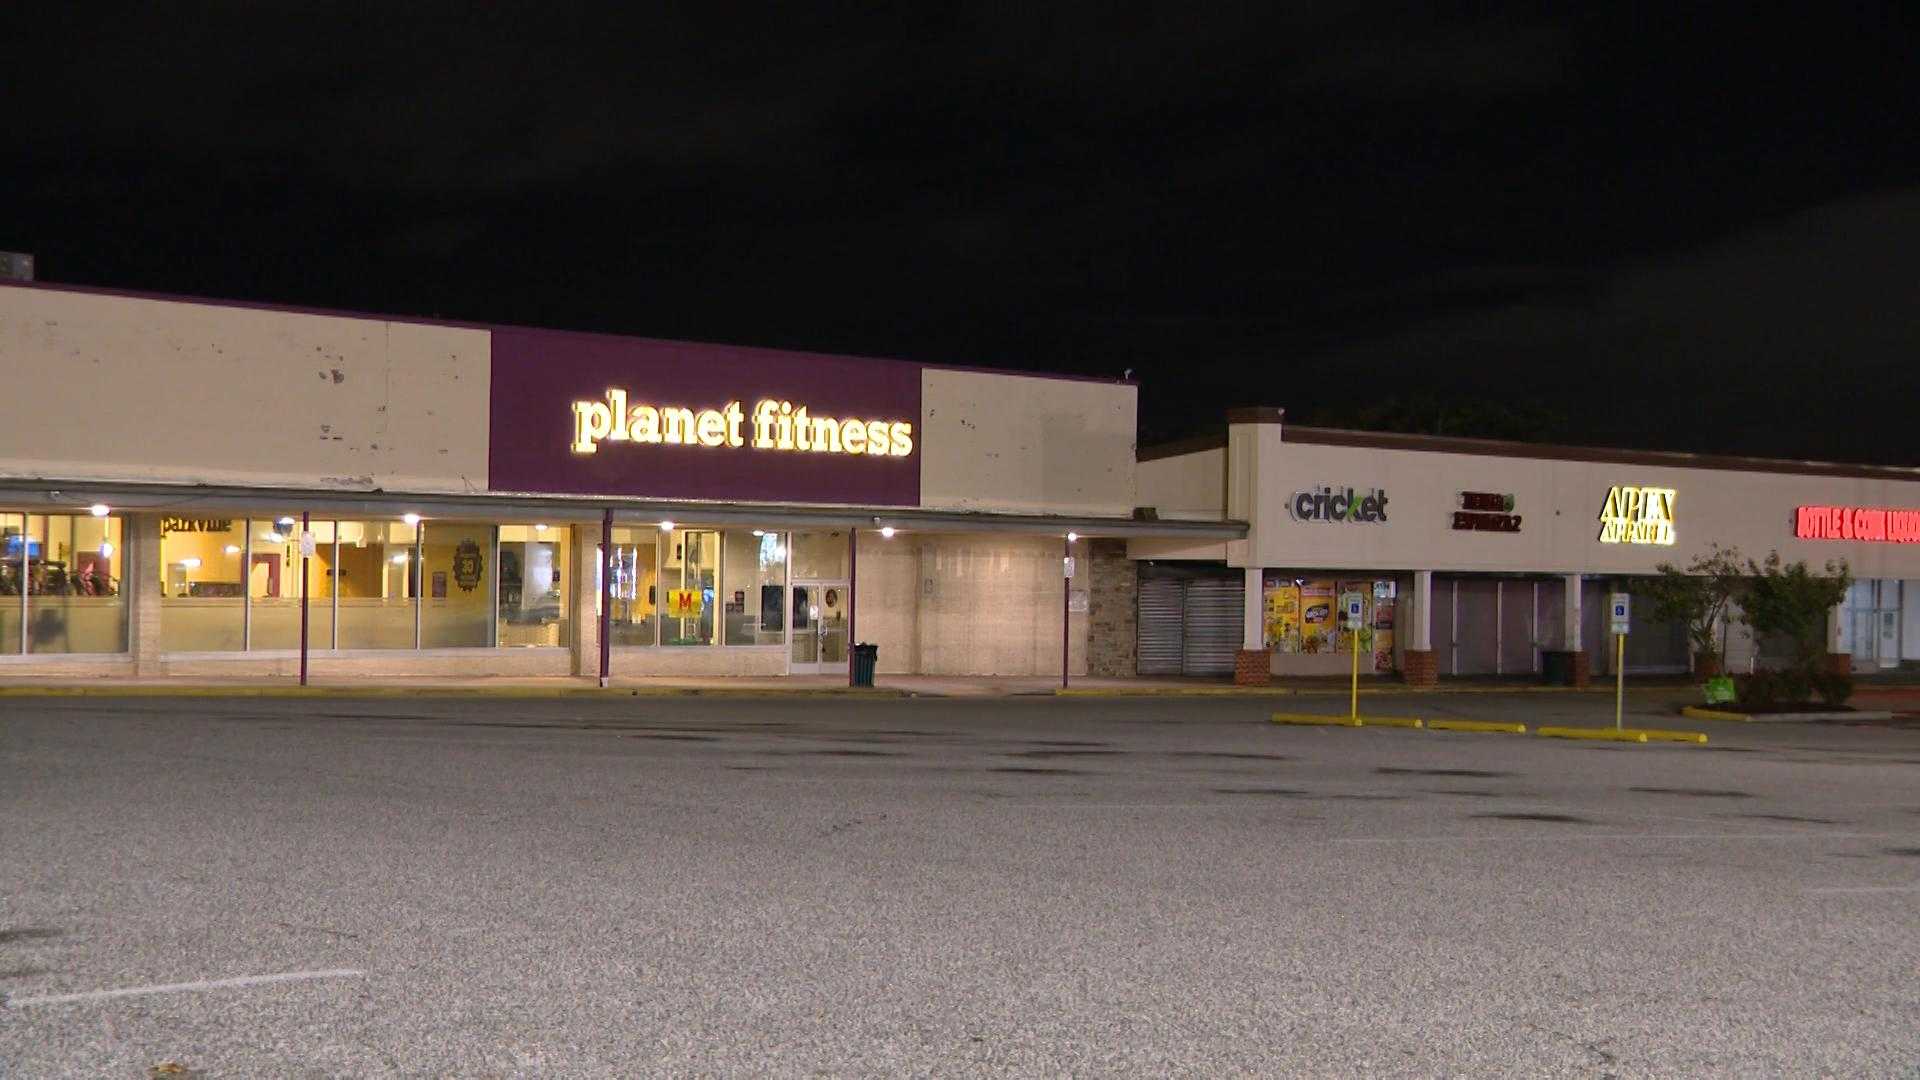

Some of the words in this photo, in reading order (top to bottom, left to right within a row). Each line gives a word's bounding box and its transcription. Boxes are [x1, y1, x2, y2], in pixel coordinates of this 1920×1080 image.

[571, 388, 744, 453] planet
[752, 399, 913, 457] fitness
[1296, 486, 1389, 522] cricket
